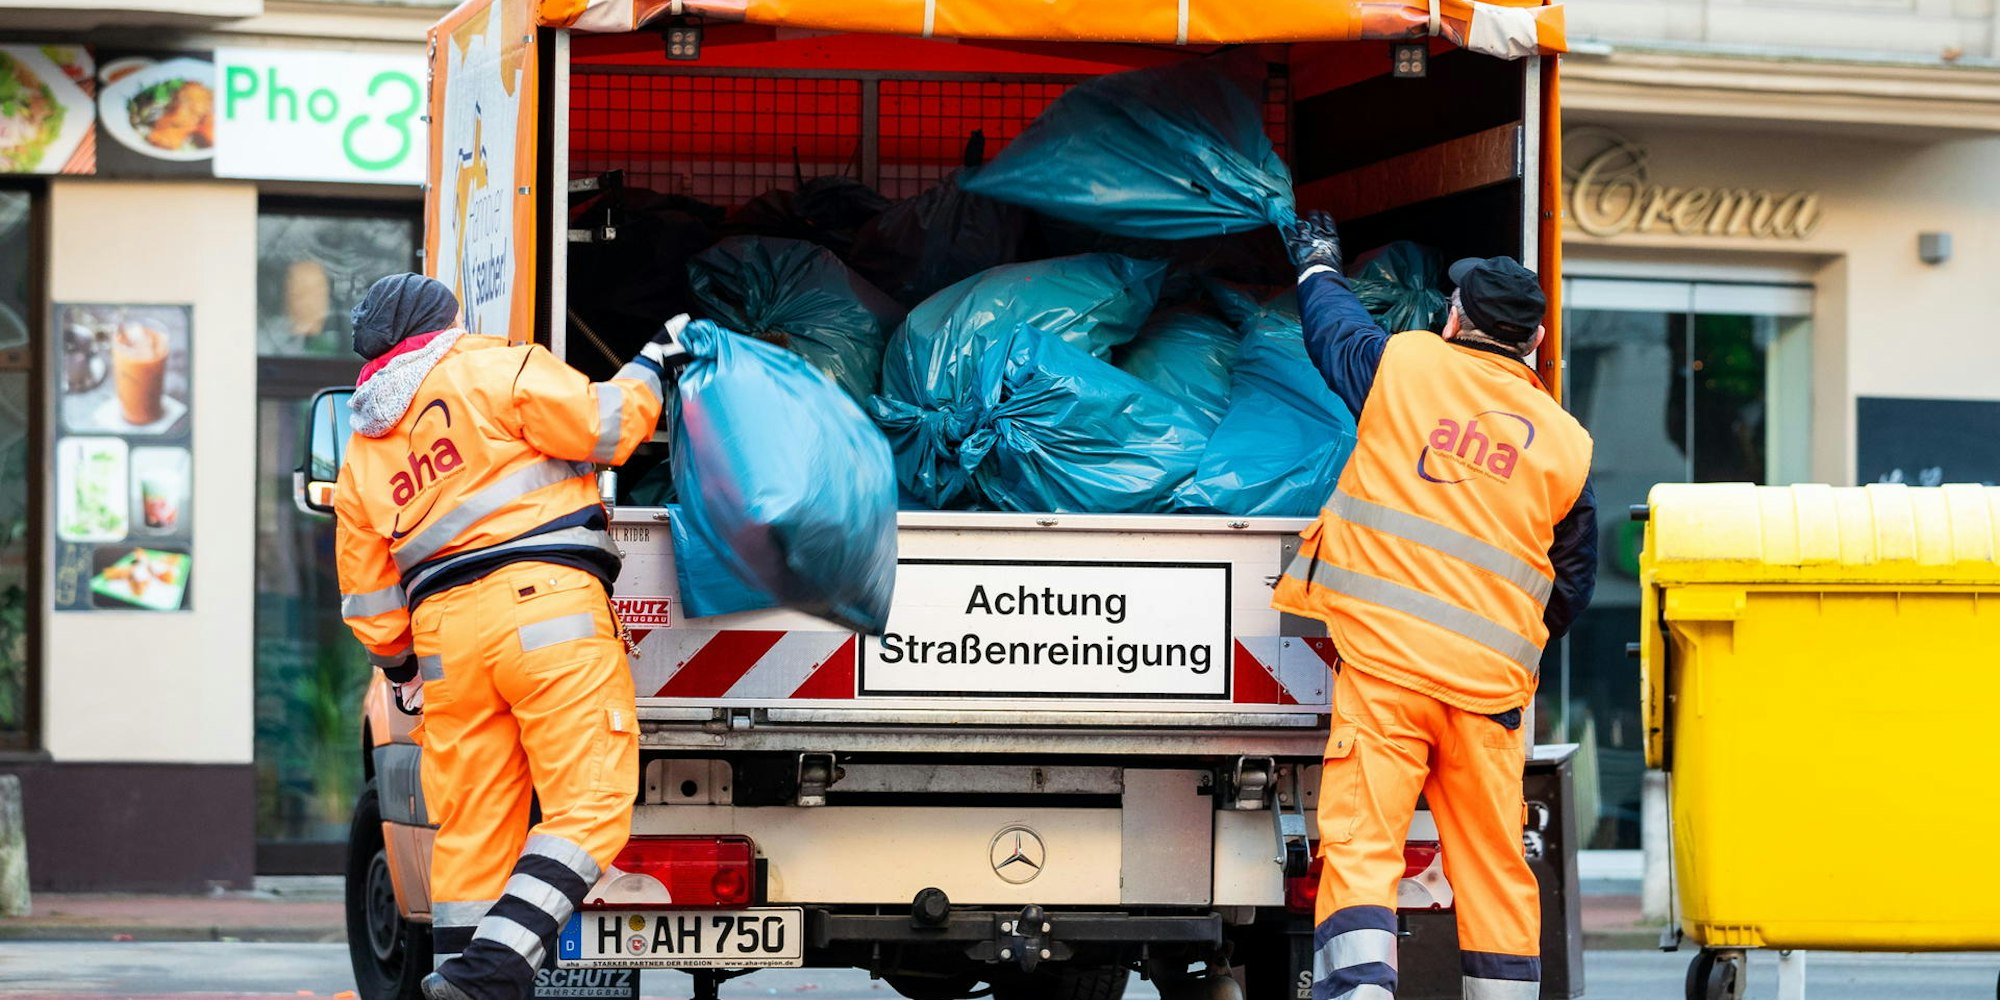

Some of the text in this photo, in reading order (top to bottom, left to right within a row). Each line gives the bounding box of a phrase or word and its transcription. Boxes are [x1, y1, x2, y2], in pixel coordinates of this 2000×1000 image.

[226, 66, 339, 123] Pho
[1563, 126, 1820, 238] Crema
[1428, 418, 1519, 480] aha
[389, 437, 464, 507] aha
[608, 527, 650, 542] LL RIDER
[610, 600, 669, 614] HUTZ
[619, 615, 668, 623] ZEUGBAU
[965, 584, 1127, 624] Achtung
[878, 632, 1212, 675] Straßenreinigung
[566, 940, 575, 951] D
[598, 916, 785, 954] H AH 750
[534, 968, 632, 987] SCHUTZ
[537, 988, 629, 997] FAHRZEUGBAU
